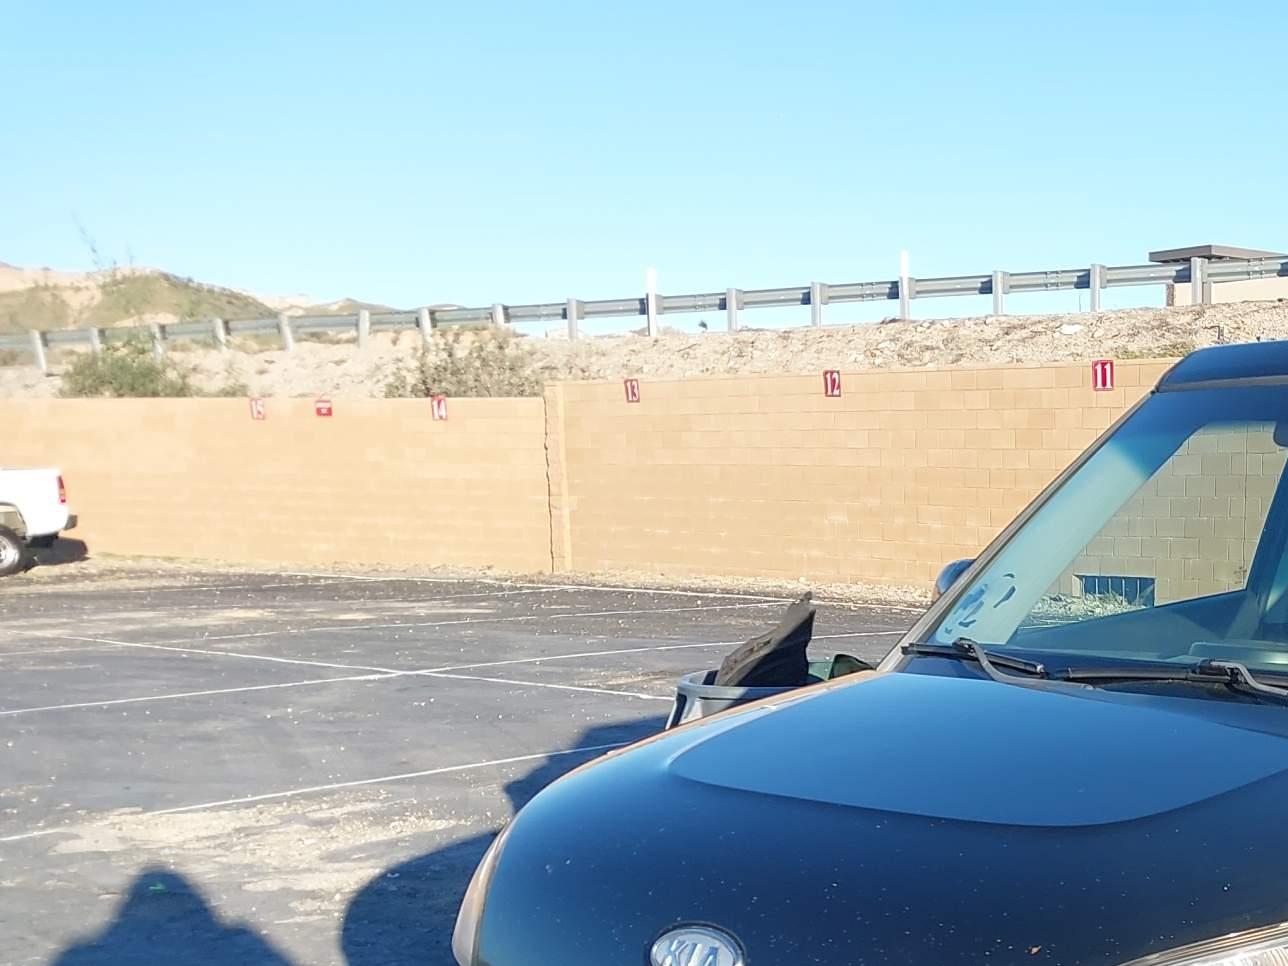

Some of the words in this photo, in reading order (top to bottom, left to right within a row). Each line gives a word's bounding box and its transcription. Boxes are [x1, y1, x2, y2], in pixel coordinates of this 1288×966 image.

[825, 372, 840, 396] 12
[1094, 362, 1113, 389] 11
[626, 380, 639, 401] 13
